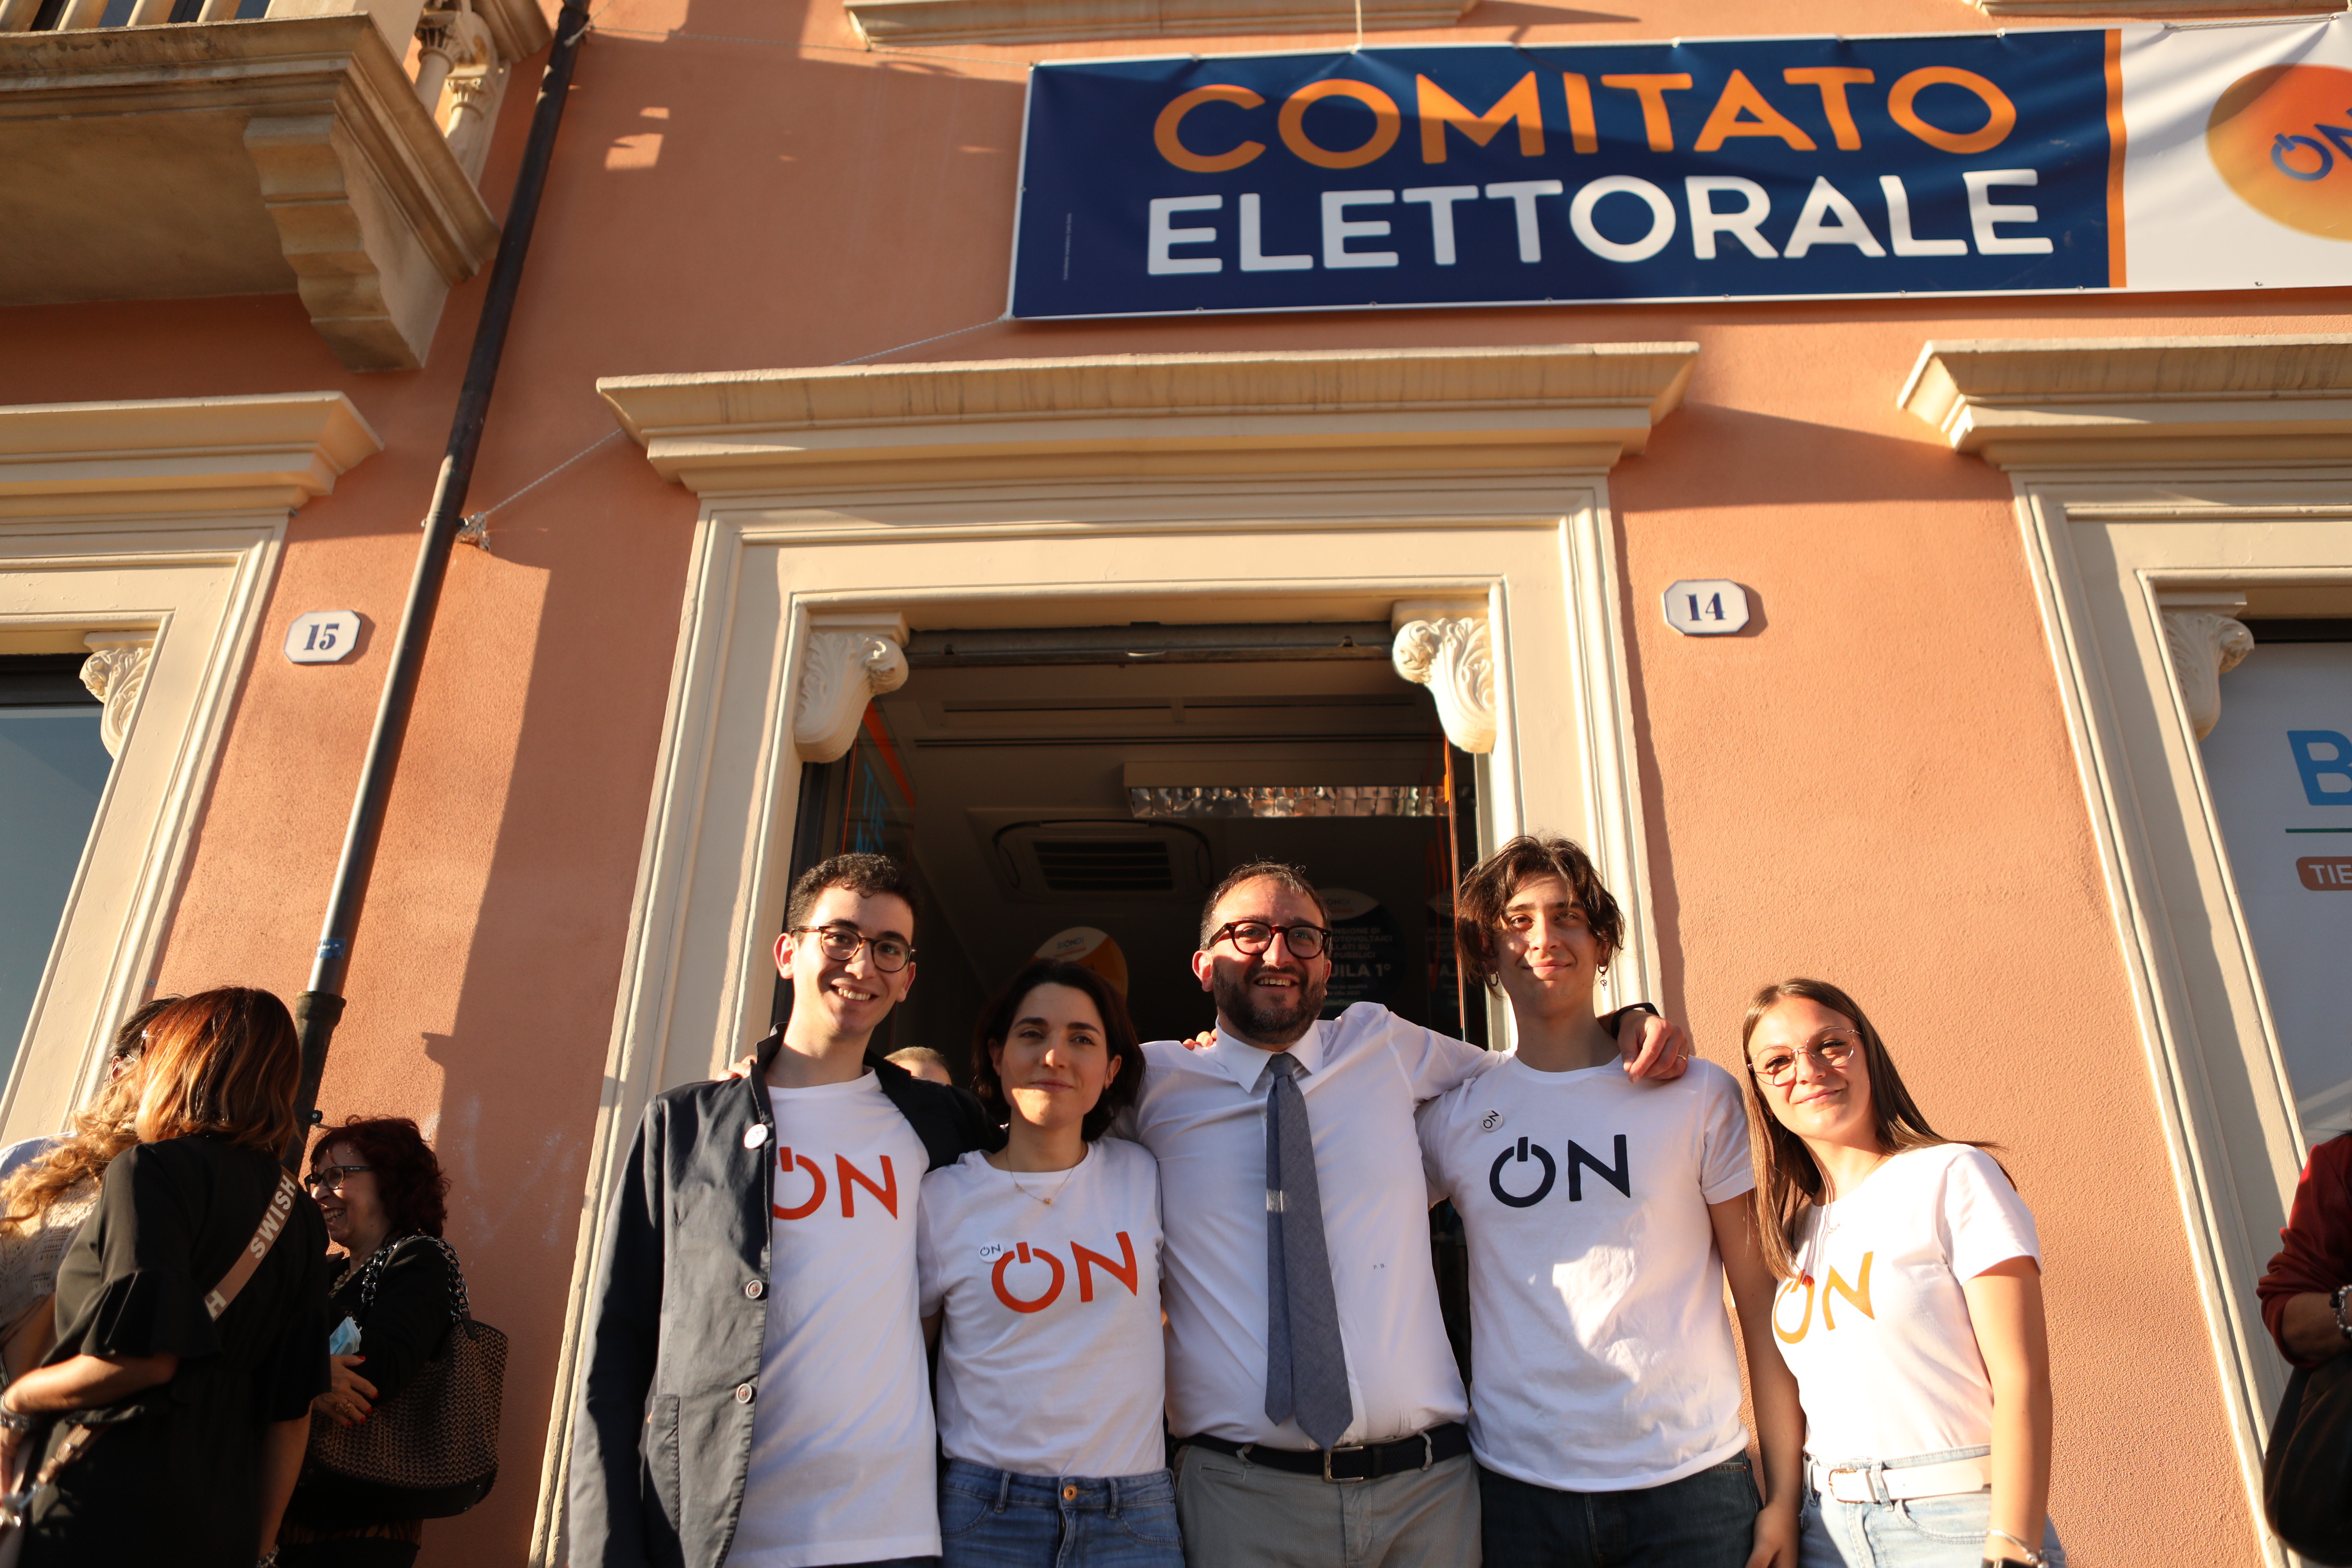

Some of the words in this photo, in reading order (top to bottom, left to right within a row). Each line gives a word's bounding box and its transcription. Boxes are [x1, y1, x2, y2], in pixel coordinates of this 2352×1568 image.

[1154, 66, 2017, 173] COMITATO
[1148, 169, 2054, 276] ELETTORALE
[303, 623, 340, 651] 15
[1685, 592, 1727, 621] 14
[2287, 730, 2352, 806] B
[2308, 864, 2352, 884] TIE
[1483, 1110, 1500, 1129] ON
[1489, 1134, 1631, 1208] ON
[250, 1174, 296, 1259] SWISH
[979, 1243, 1001, 1256] ON
[991, 1231, 1138, 1314] ON
[1773, 1250, 1875, 1344] ON
